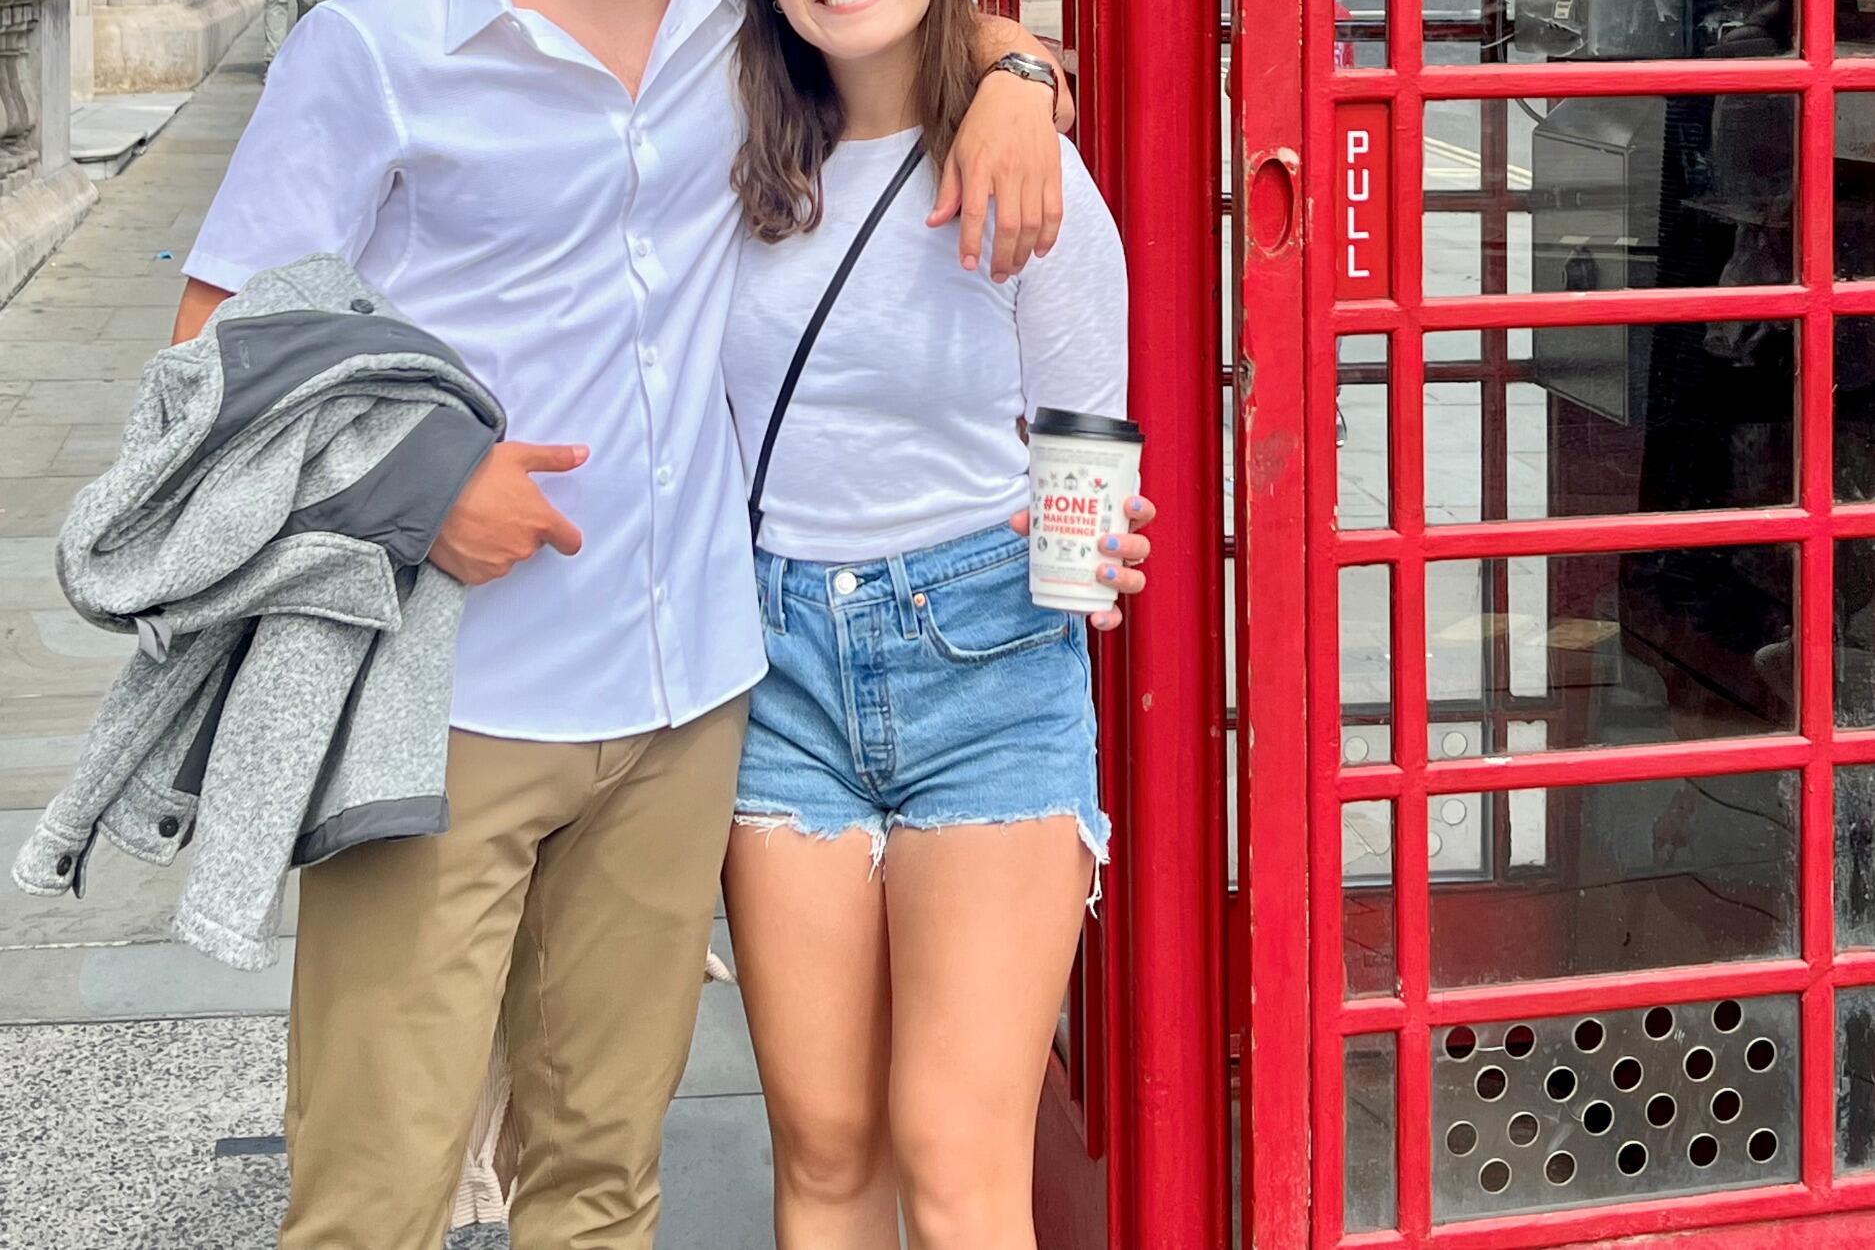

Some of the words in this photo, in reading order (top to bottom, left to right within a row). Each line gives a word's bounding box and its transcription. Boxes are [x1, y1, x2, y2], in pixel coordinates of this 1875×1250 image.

[1347, 130, 1370, 278] PULL
[1043, 494, 1098, 514] #ONE
[1043, 524, 1096, 537] DIFFERENCE
